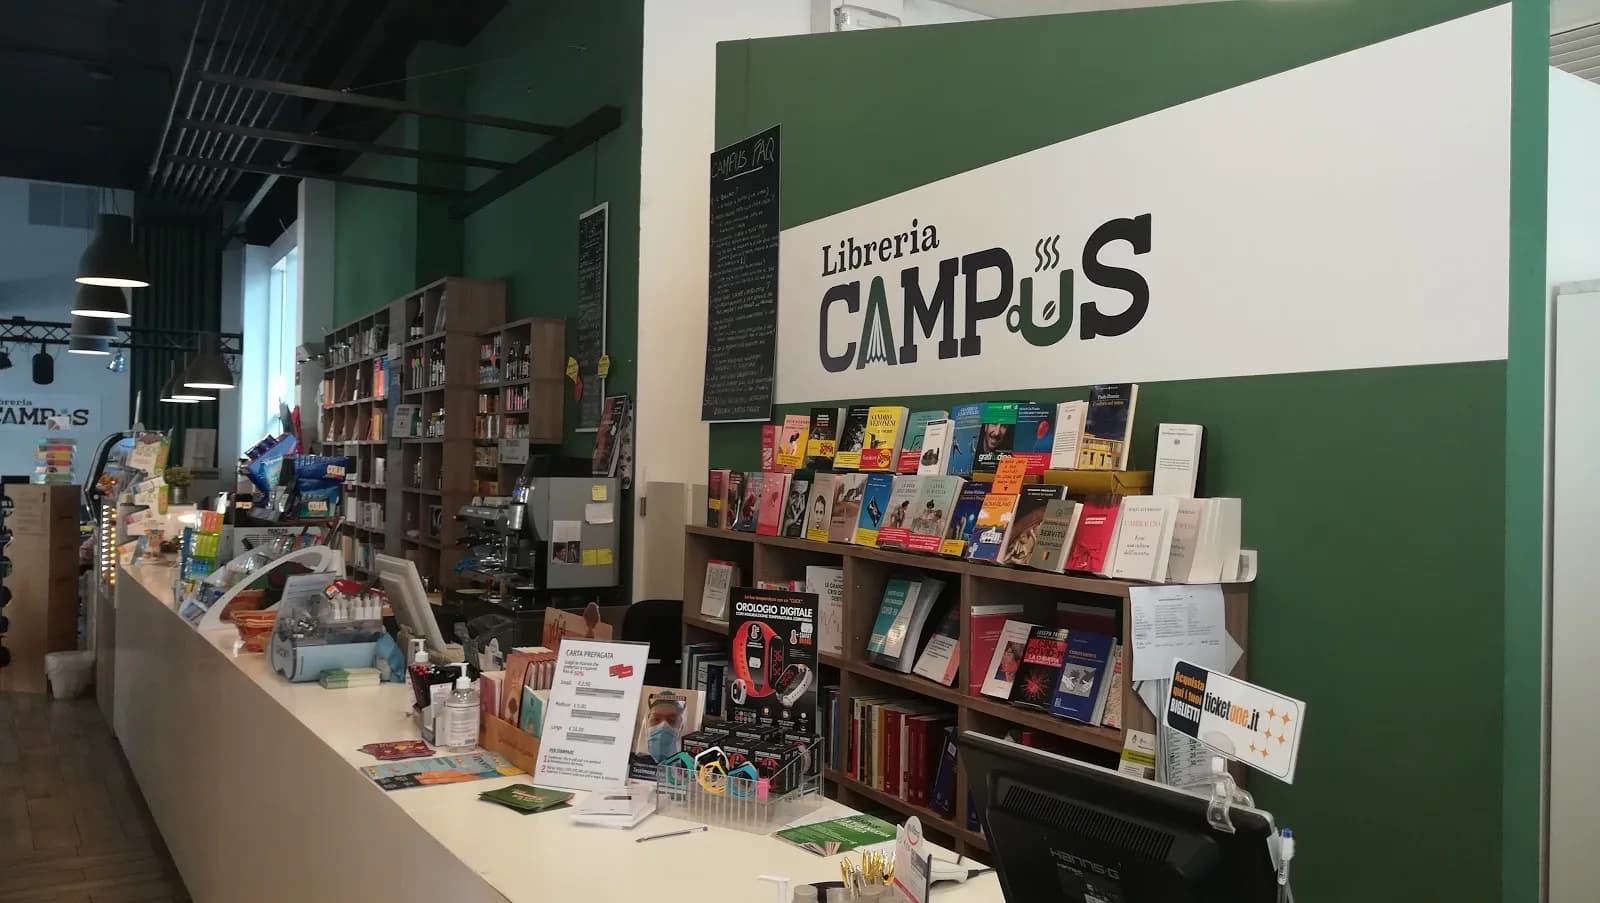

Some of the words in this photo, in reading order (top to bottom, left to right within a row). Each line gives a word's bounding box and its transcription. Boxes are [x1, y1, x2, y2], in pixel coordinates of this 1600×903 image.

[752, 137, 775, 167] FAQ
[822, 218, 940, 277] Libreria
[819, 213, 1152, 373] CAMPUS
[0, 407, 89, 426] AMPS
[735, 602, 778, 615] OROLOGIO
[780, 606, 813, 618] DIGITALE
[566, 649, 583, 657] CARTA
[583, 650, 614, 660] PREPAGATA
[1175, 672, 1205, 691] Acquista
[1173, 686, 1184, 698] qui
[1188, 690, 1202, 705] tuoi
[1170, 698, 1200, 723] BIGLIETTI
[1204, 692, 1260, 732] ticketone.it
